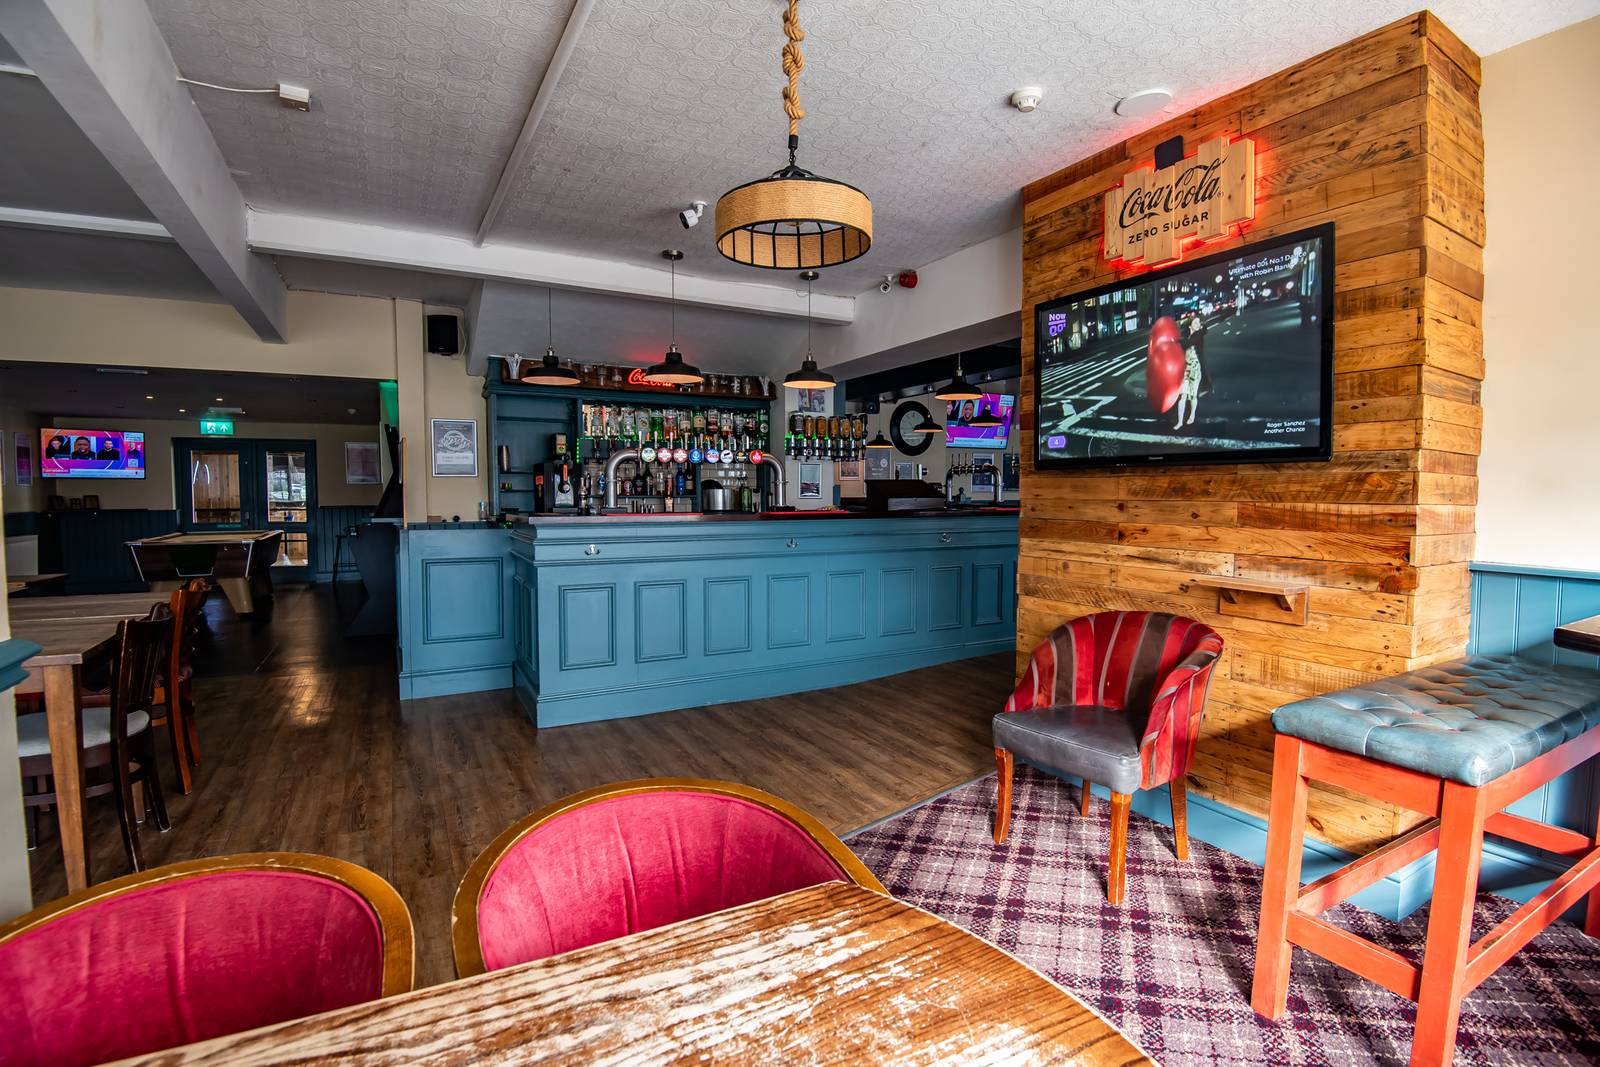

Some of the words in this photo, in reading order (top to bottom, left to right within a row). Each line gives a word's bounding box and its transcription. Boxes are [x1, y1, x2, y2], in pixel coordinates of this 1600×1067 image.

[1128, 227, 1158, 244] ZERO
[1163, 211, 1209, 232] SUGAR
[1240, 272, 1254, 280] with
[1254, 267, 1274, 277] Robin
